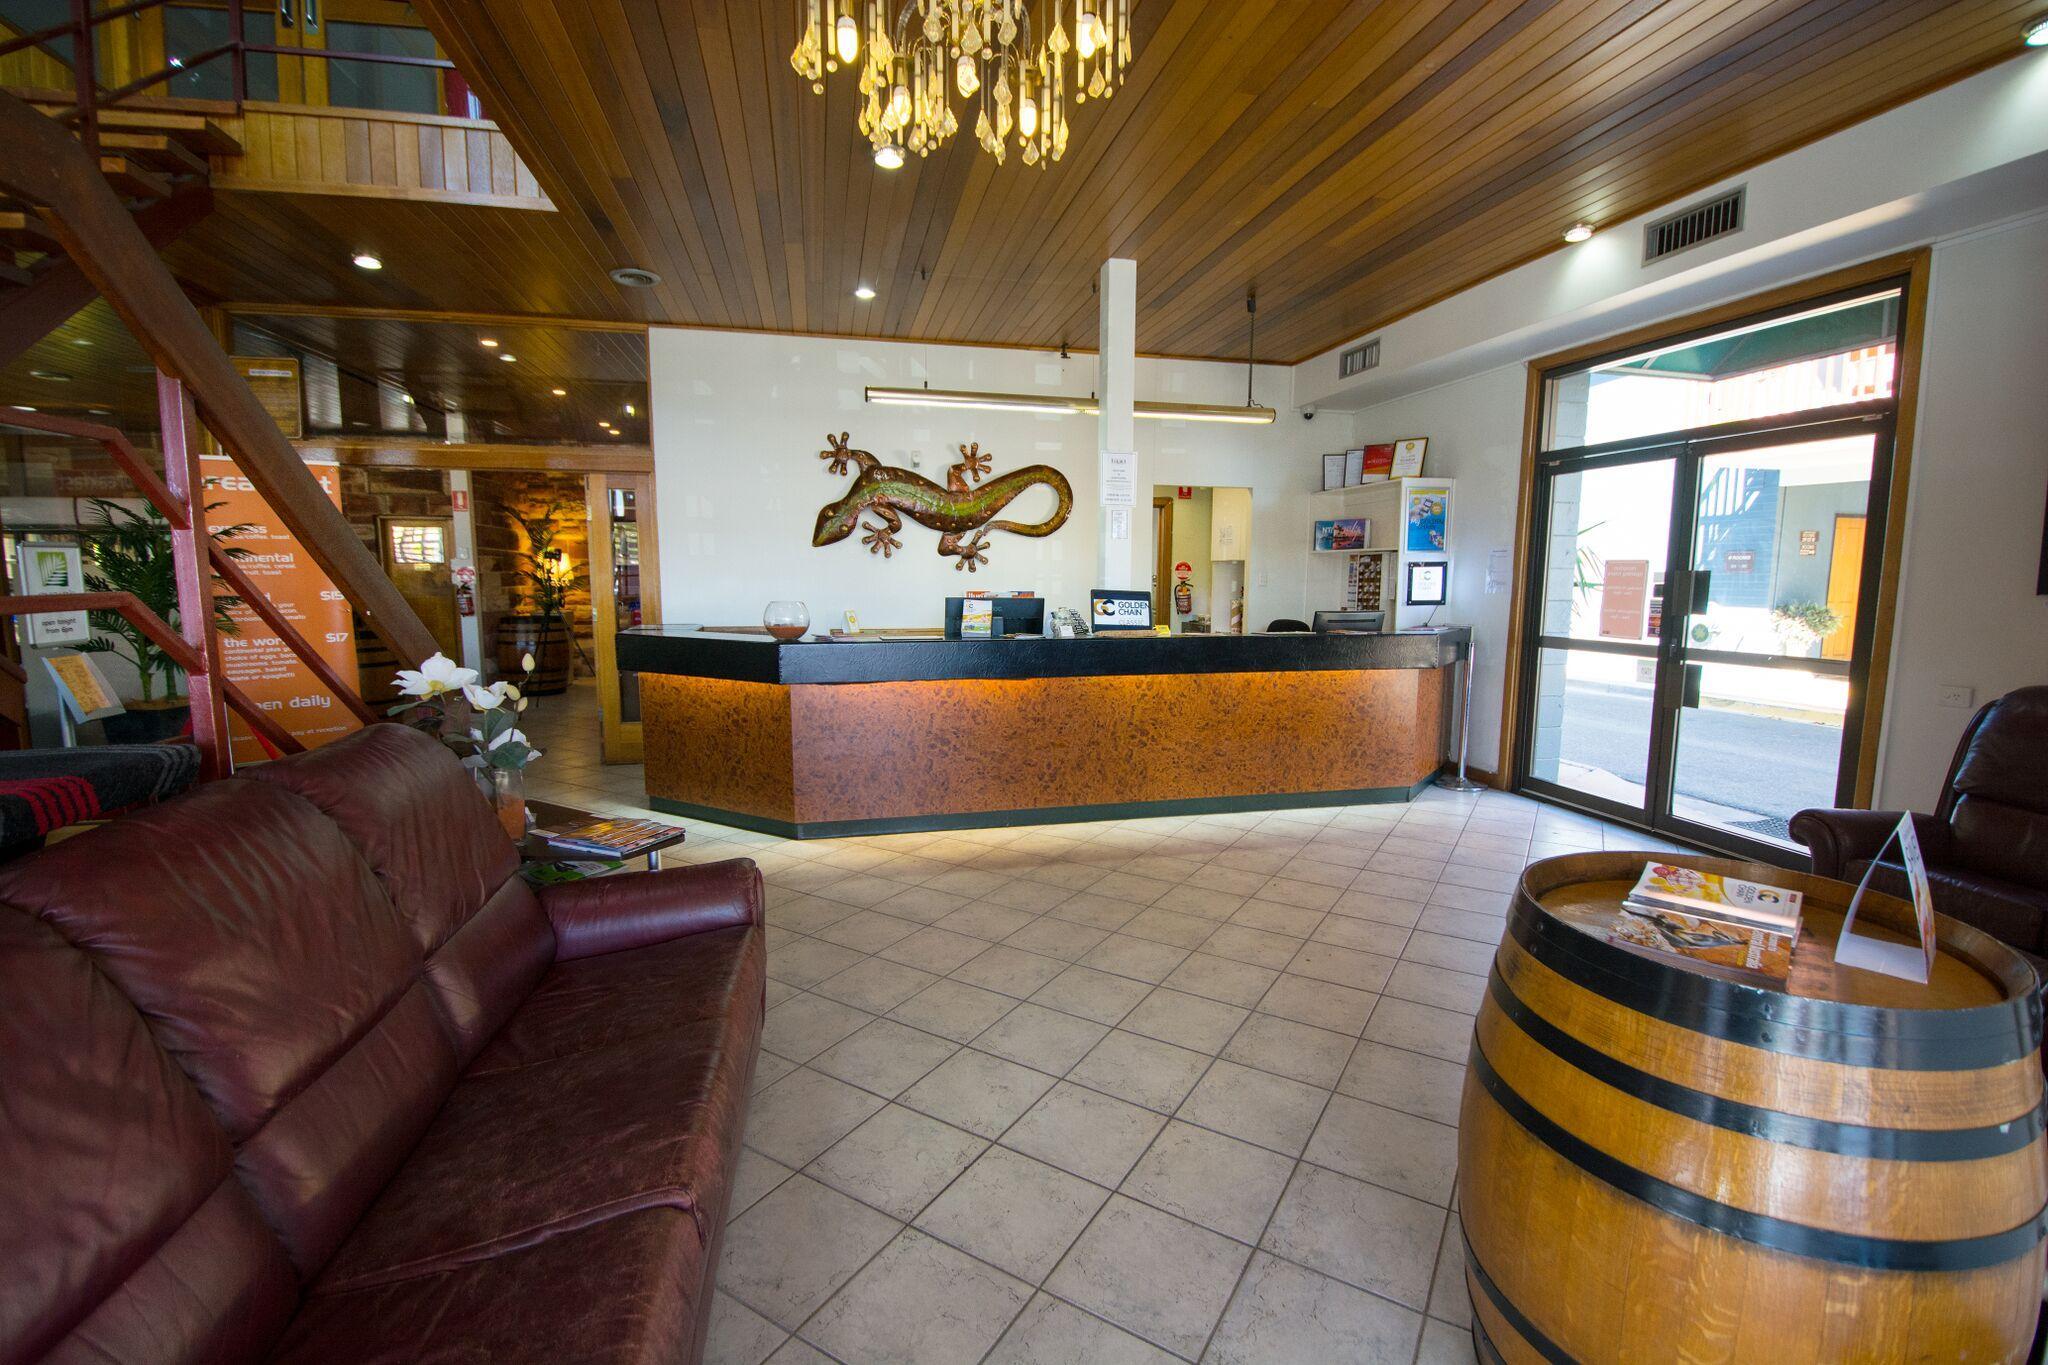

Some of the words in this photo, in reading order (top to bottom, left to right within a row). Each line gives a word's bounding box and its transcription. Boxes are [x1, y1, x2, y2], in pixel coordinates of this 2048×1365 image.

[223, 637, 248, 647] the
[325, 632, 348, 643] $17
[289, 694, 331, 708] daily
